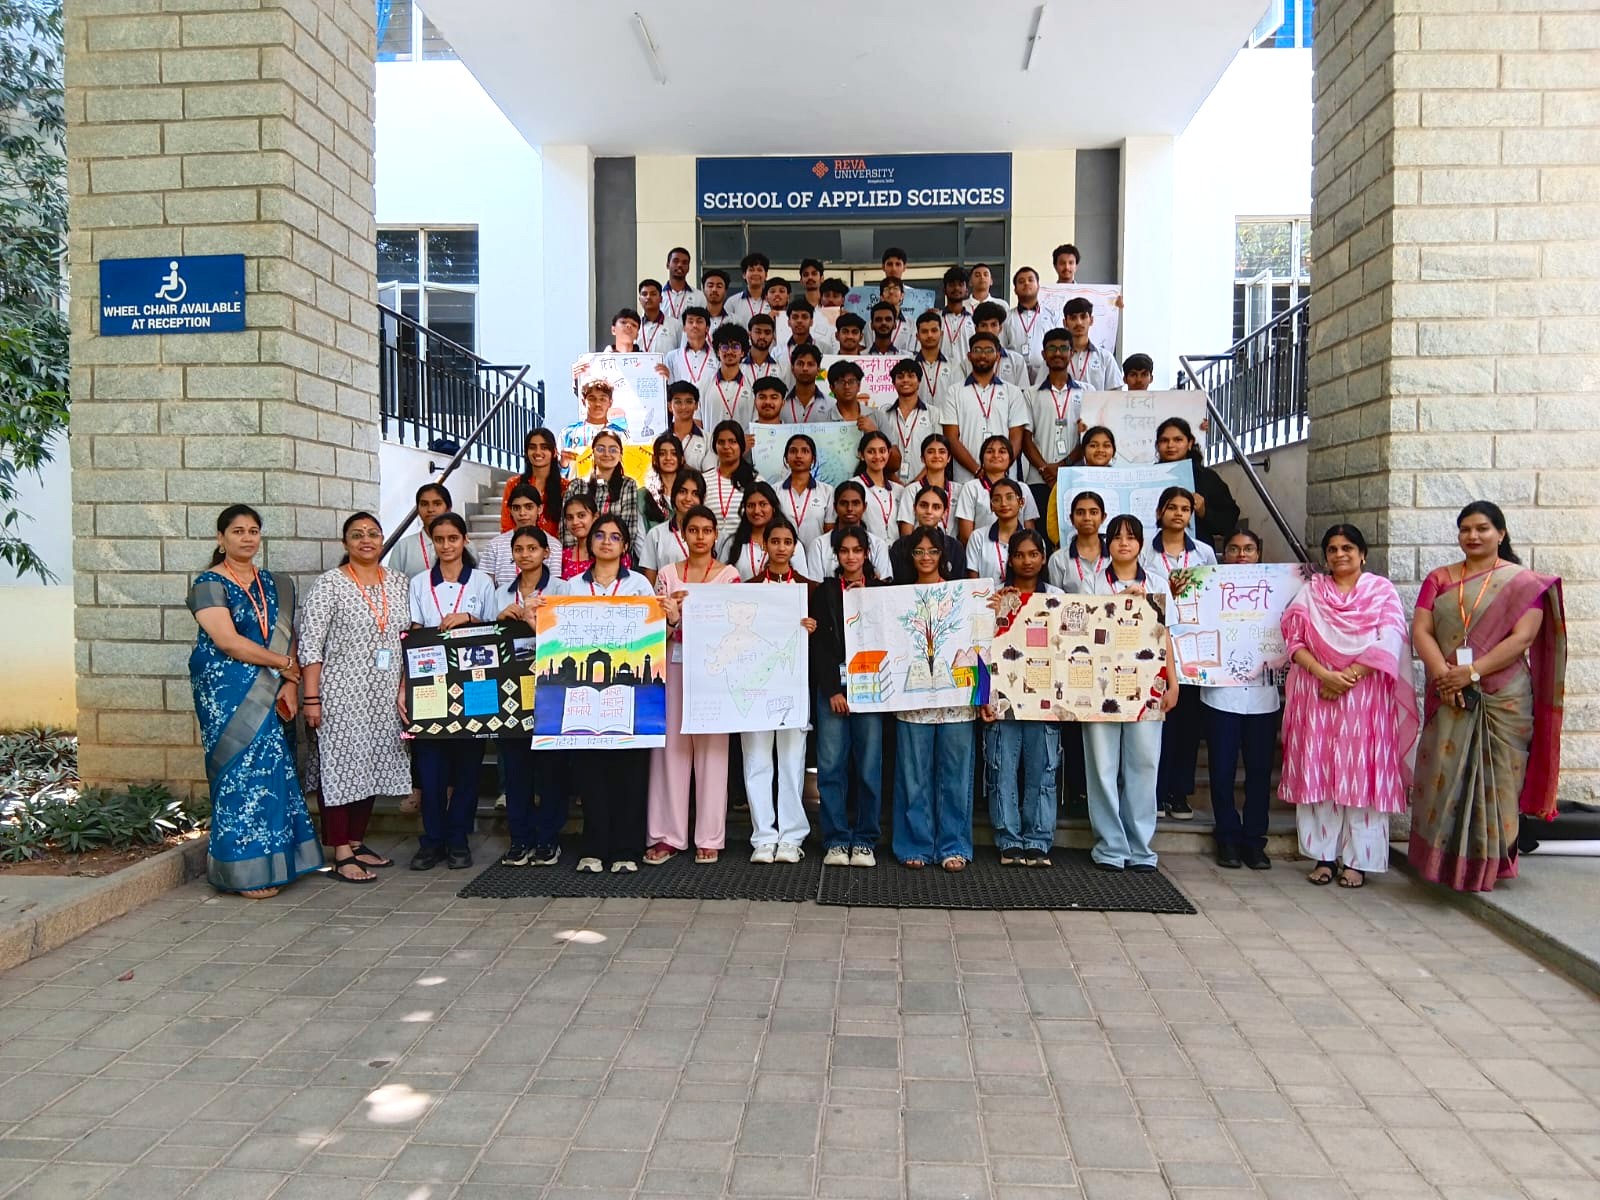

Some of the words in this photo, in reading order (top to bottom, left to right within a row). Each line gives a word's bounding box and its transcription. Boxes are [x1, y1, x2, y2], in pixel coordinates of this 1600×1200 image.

[834, 159, 866, 170] REVA
[834, 168, 895, 179] UNIVERSITY
[703, 191, 783, 209] SCHOOL
[786, 191, 814, 208] OF
[818, 190, 902, 208] APPLIED
[907, 188, 1005, 206] SCIENCES
[103, 305, 141, 317] WHEEL
[143, 305, 178, 316] CHAIR
[180, 302, 241, 314] AVAILABLE
[131, 318, 146, 330] AT
[147, 317, 211, 329] RECEPTION
[1221, 579, 1271, 611] हिन्दी
